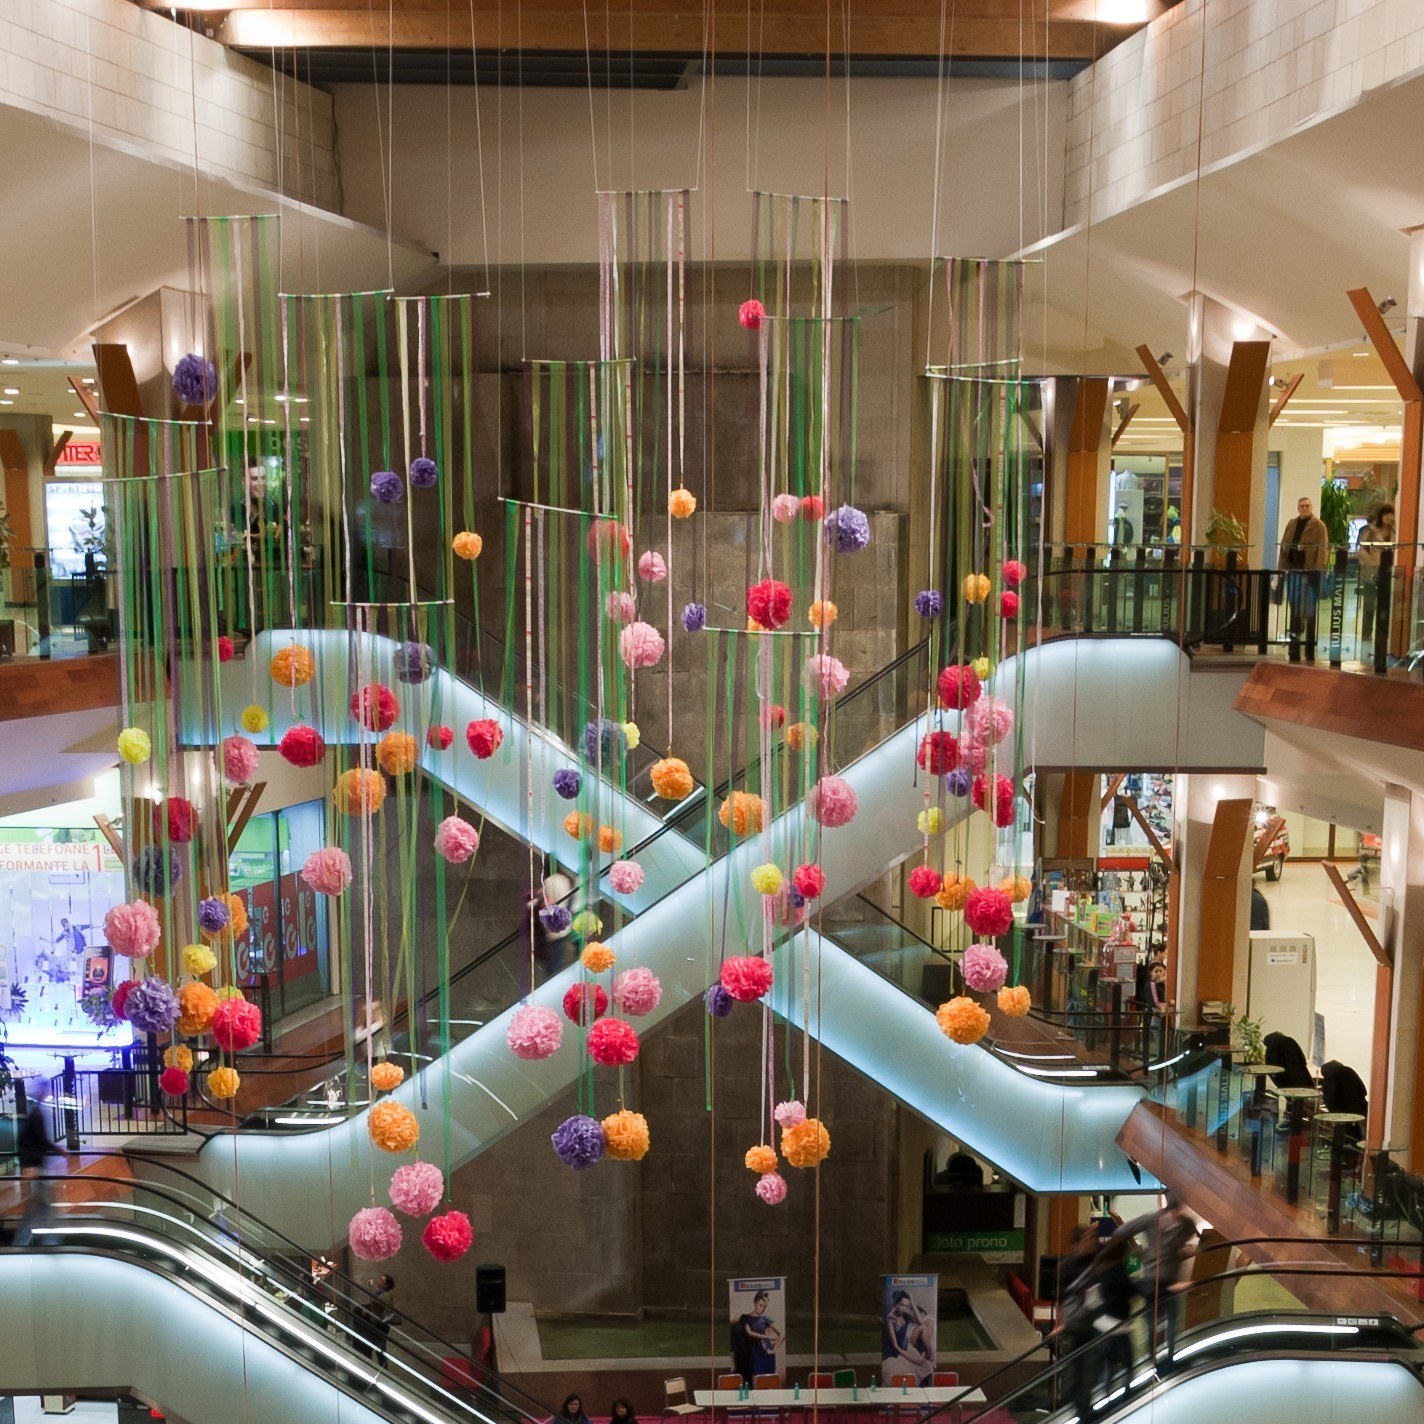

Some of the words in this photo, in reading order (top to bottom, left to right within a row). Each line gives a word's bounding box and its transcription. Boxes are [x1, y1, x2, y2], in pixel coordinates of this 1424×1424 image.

[1333, 577, 1343, 607] MALL
[1331, 609, 1342, 648] IULIUS
[16, 843, 90, 855] TELEFOANE
[73, 859, 90, 871] LA
